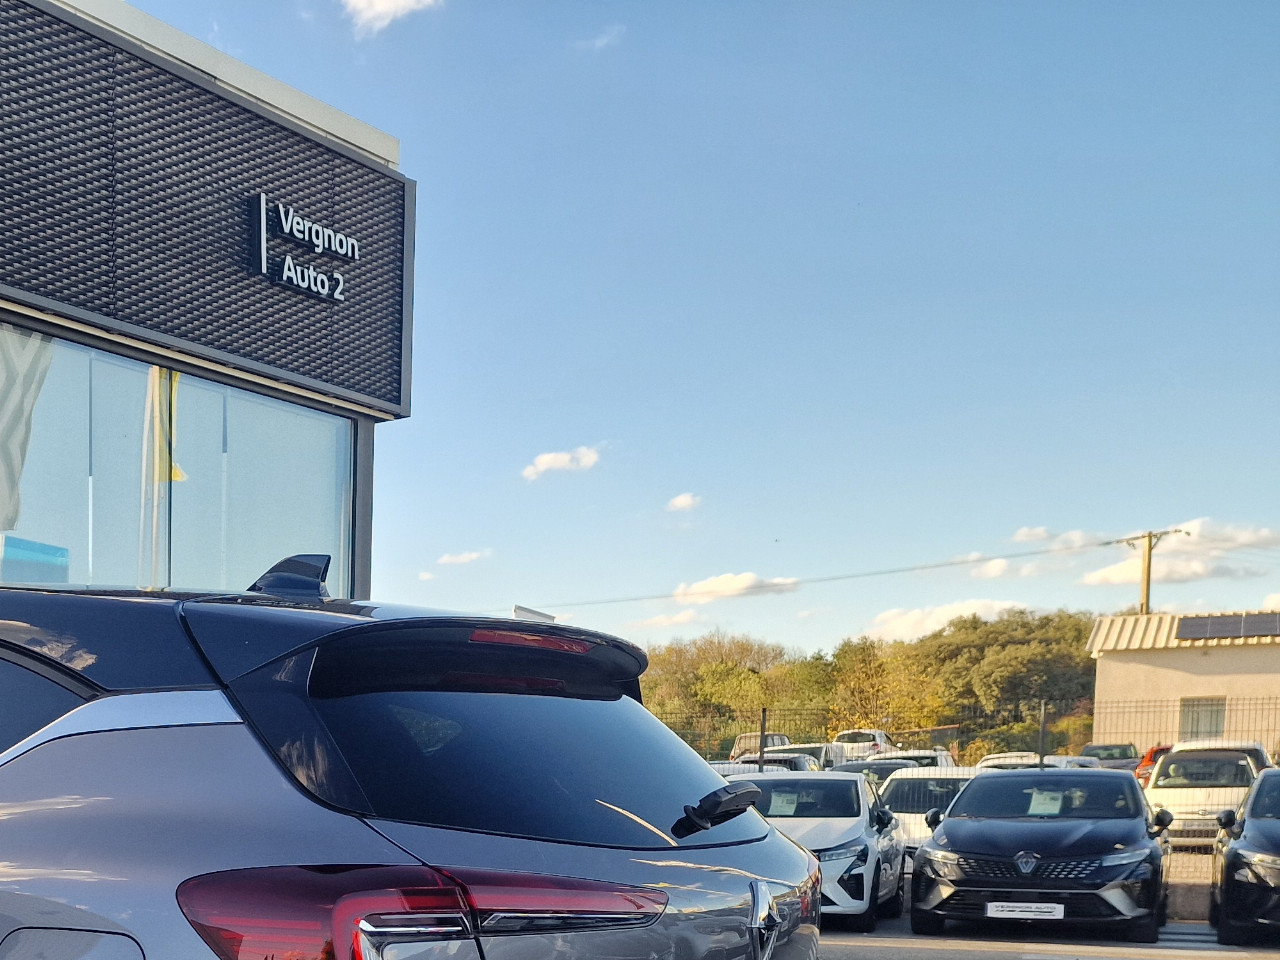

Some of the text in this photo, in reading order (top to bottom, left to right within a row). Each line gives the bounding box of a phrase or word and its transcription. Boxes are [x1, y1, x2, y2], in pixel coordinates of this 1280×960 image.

[279, 203, 359, 260] Vergnon
[282, 255, 345, 301] Auto 2
